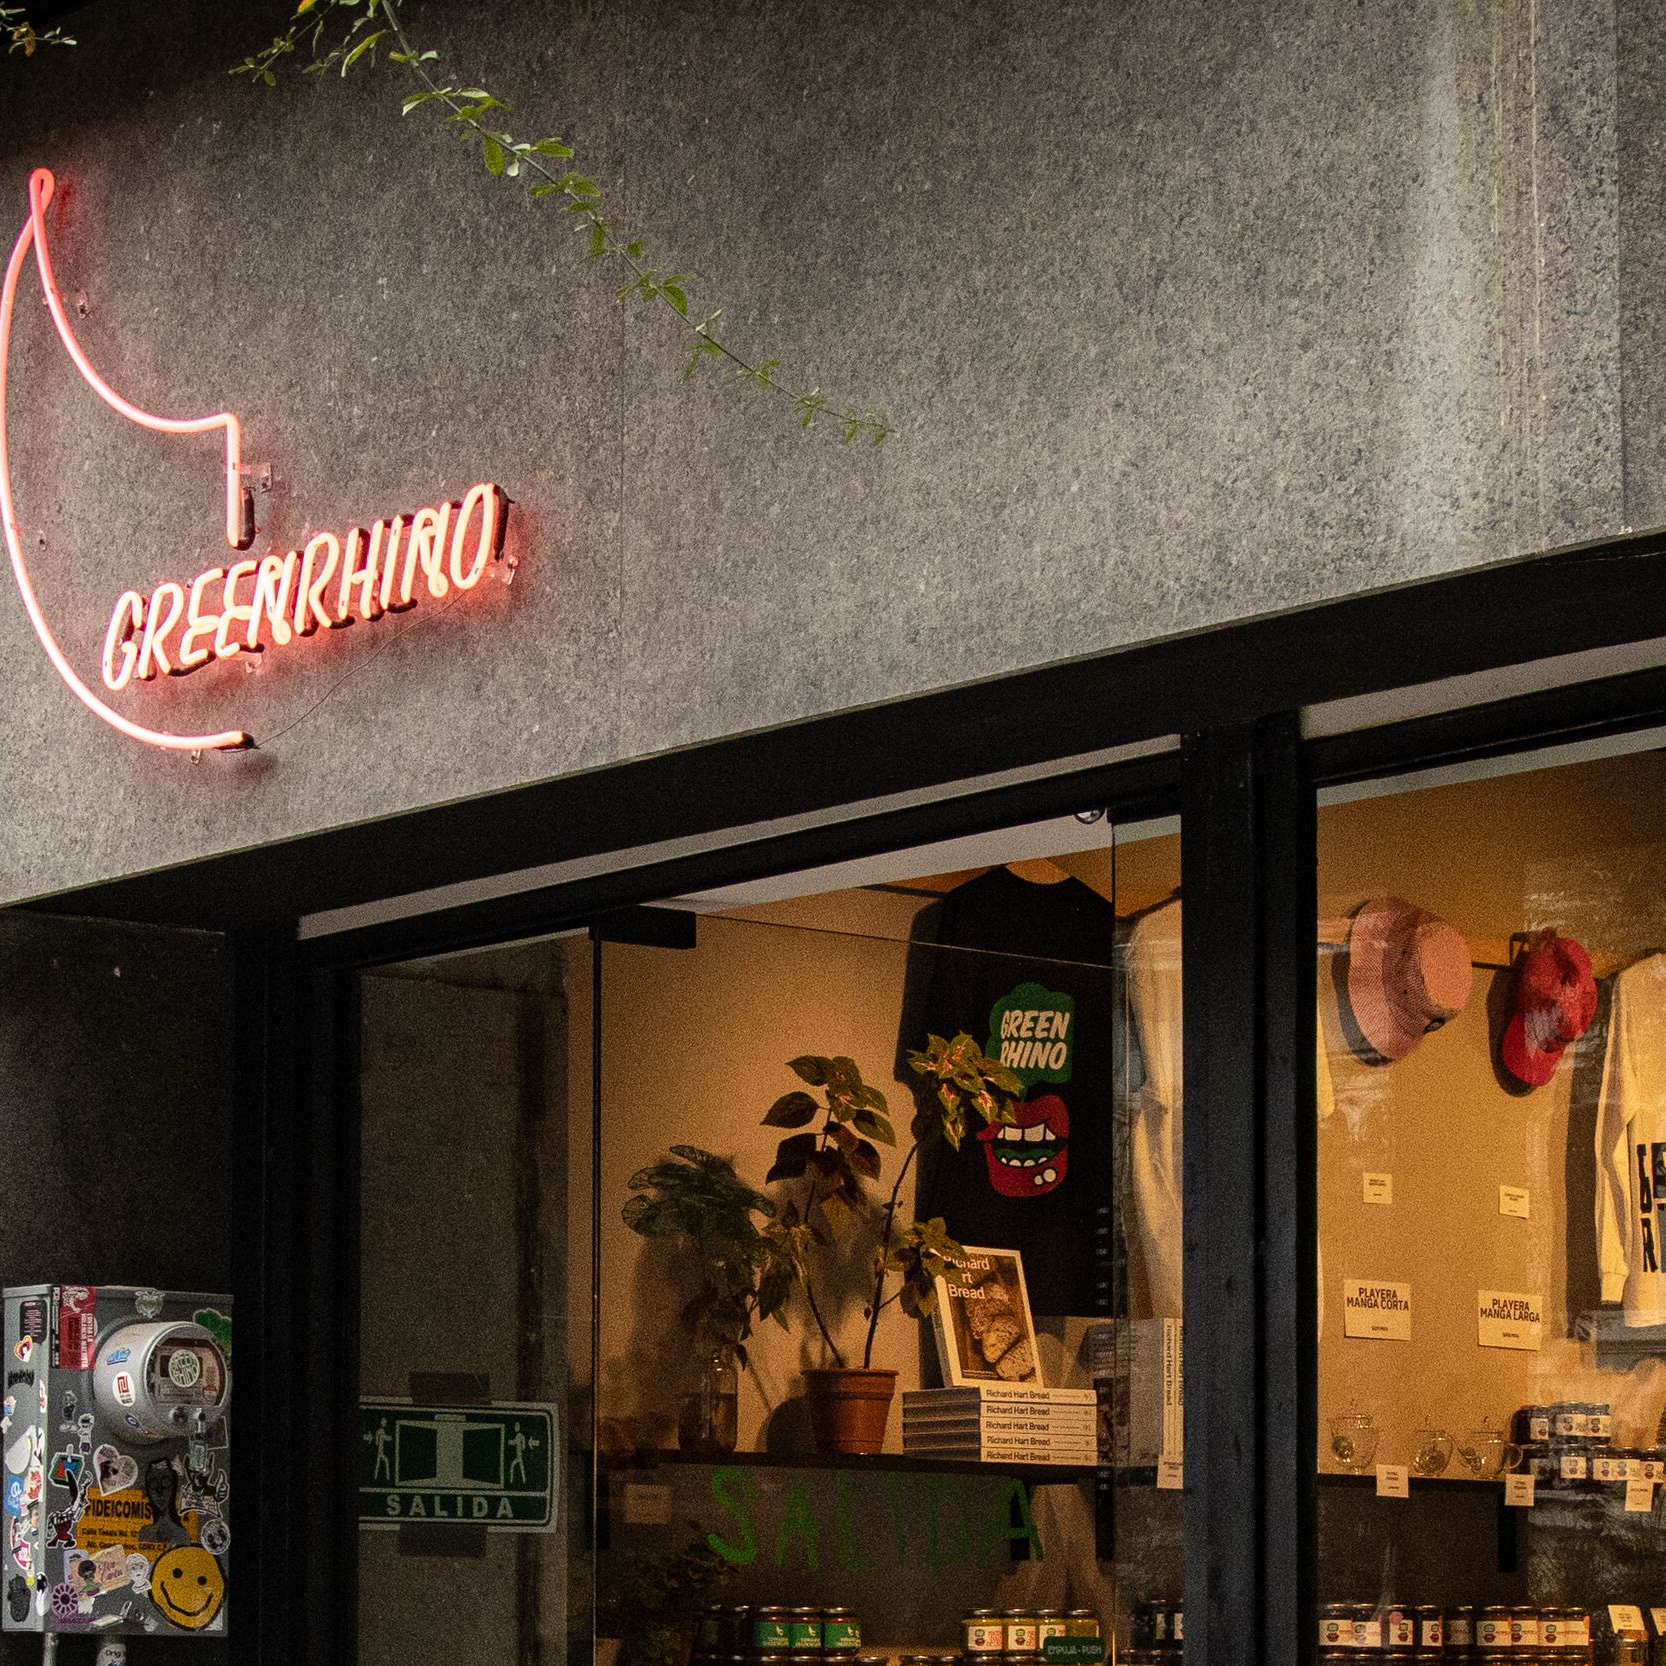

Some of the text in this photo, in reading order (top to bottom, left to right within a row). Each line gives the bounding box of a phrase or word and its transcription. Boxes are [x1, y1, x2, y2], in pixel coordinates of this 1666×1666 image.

[1000, 1008, 1071, 1041] GREEN
[999, 1039, 1068, 1072] RHINO
[948, 1285, 986, 1300] Bread
[1358, 1287, 1398, 1300] PLAYERA
[1346, 1297, 1410, 1311] MANGA CORTA
[1491, 1298, 1530, 1311] PLAYERA
[1480, 1307, 1541, 1323] MANGA LARGA
[986, 1390, 1050, 1400] Richard Hart Bread
[986, 1406, 1050, 1415] Richard Hart Bread
[986, 1421, 1050, 1430] Richard Hart Bread
[987, 1436, 1051, 1446] Richard Hart Bread
[986, 1451, 1050, 1461] Richard Hart Bread
[85, 1498, 152, 1520] FIDEICOMIS
[385, 1495, 515, 1519] SALIDA
[707, 1466, 1044, 1574] SALIDA
